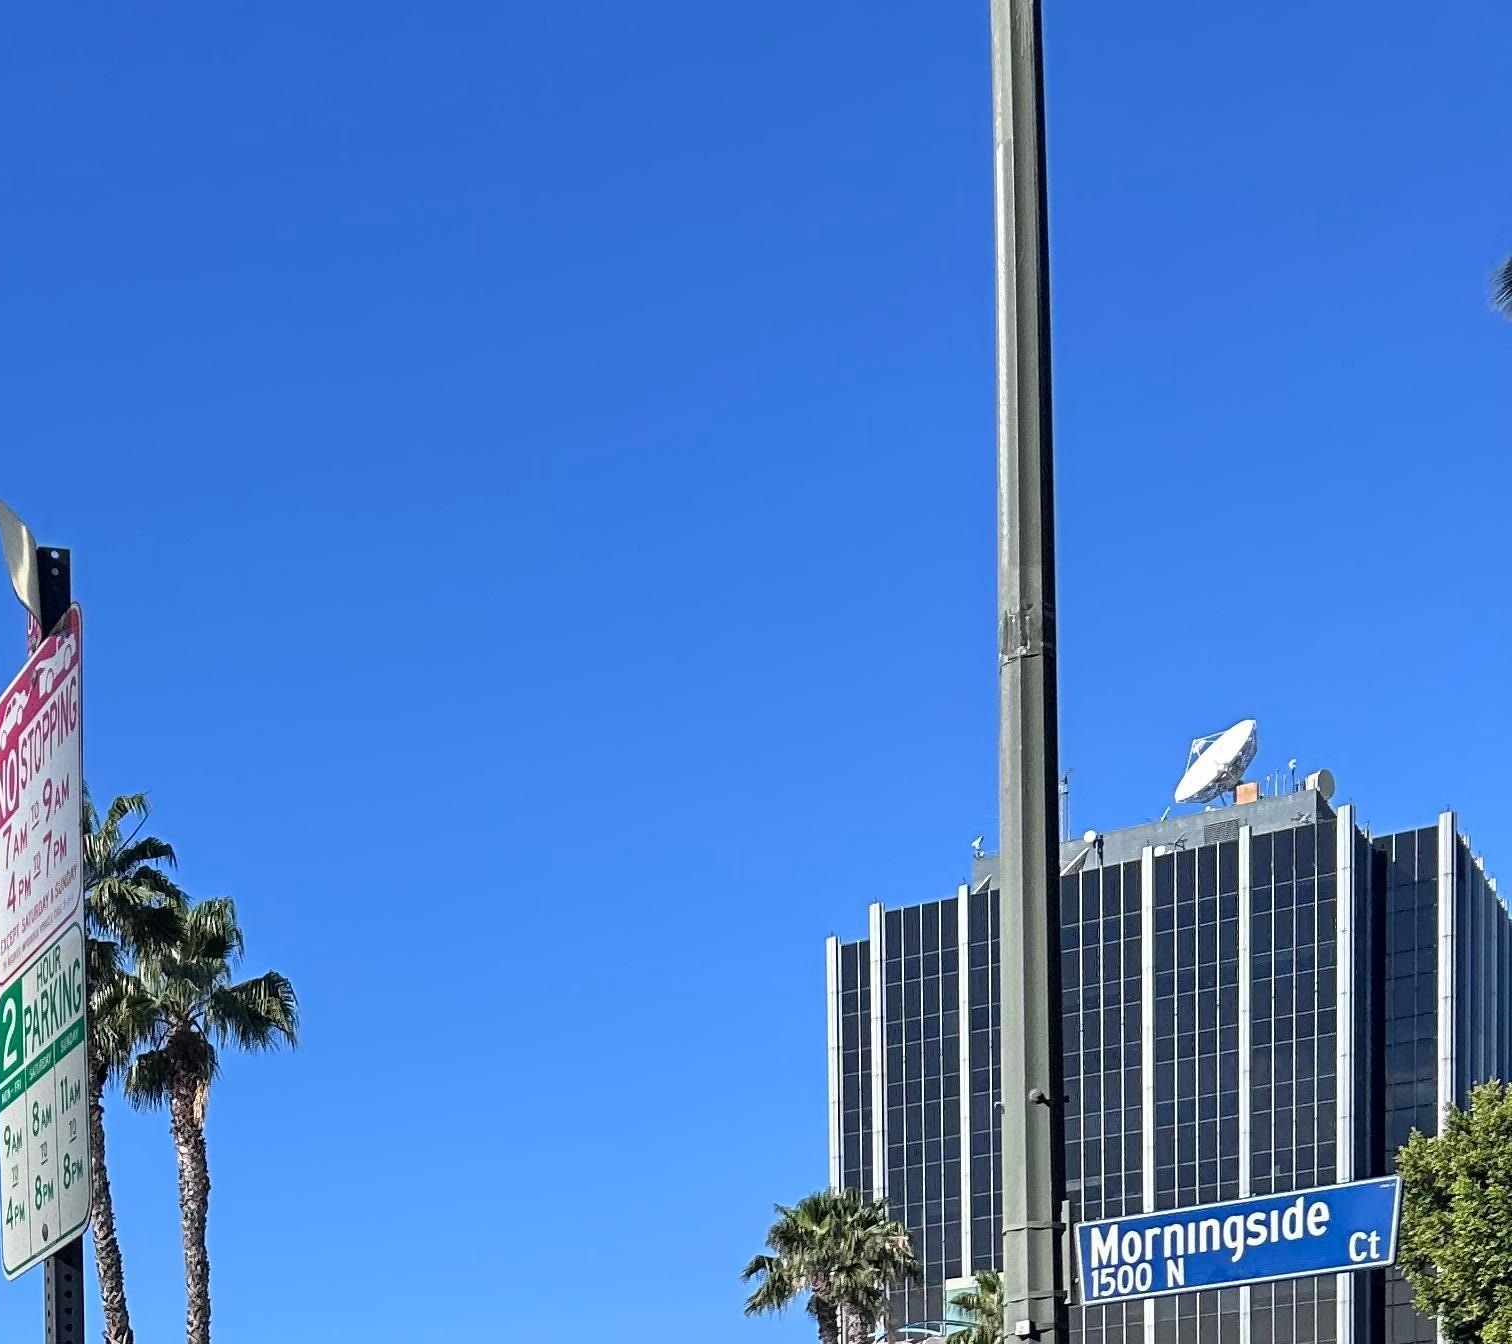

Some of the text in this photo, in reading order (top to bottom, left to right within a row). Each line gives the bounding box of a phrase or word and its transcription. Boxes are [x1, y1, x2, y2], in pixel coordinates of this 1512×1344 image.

[21, 676, 77, 790] STOPPING
[3, 822, 28, 869] 7AM
[43, 773, 70, 822] 9AM
[7, 869, 31, 913] 4PM
[43, 830, 68, 877] 7PM
[1, 923, 19, 956] EXCEPT
[22, 892, 49, 933] SATURDAY
[54, 863, 77, 898] SUNDAY
[37, 944, 61, 988] HOUR
[2, 958, 82, 1071] 2 PARKING
[60, 1076, 81, 1114] 11AM
[32, 1101, 52, 1137] 8AM
[4, 1125, 23, 1158] 9AM
[35, 1174, 54, 1210] 8PM
[63, 1153, 83, 1189] 8PM
[6, 1196, 26, 1230] 4PM
[1090, 1197, 1381, 1270] Morningside Ct
[1091, 1258, 1185, 1298] 1500 N
